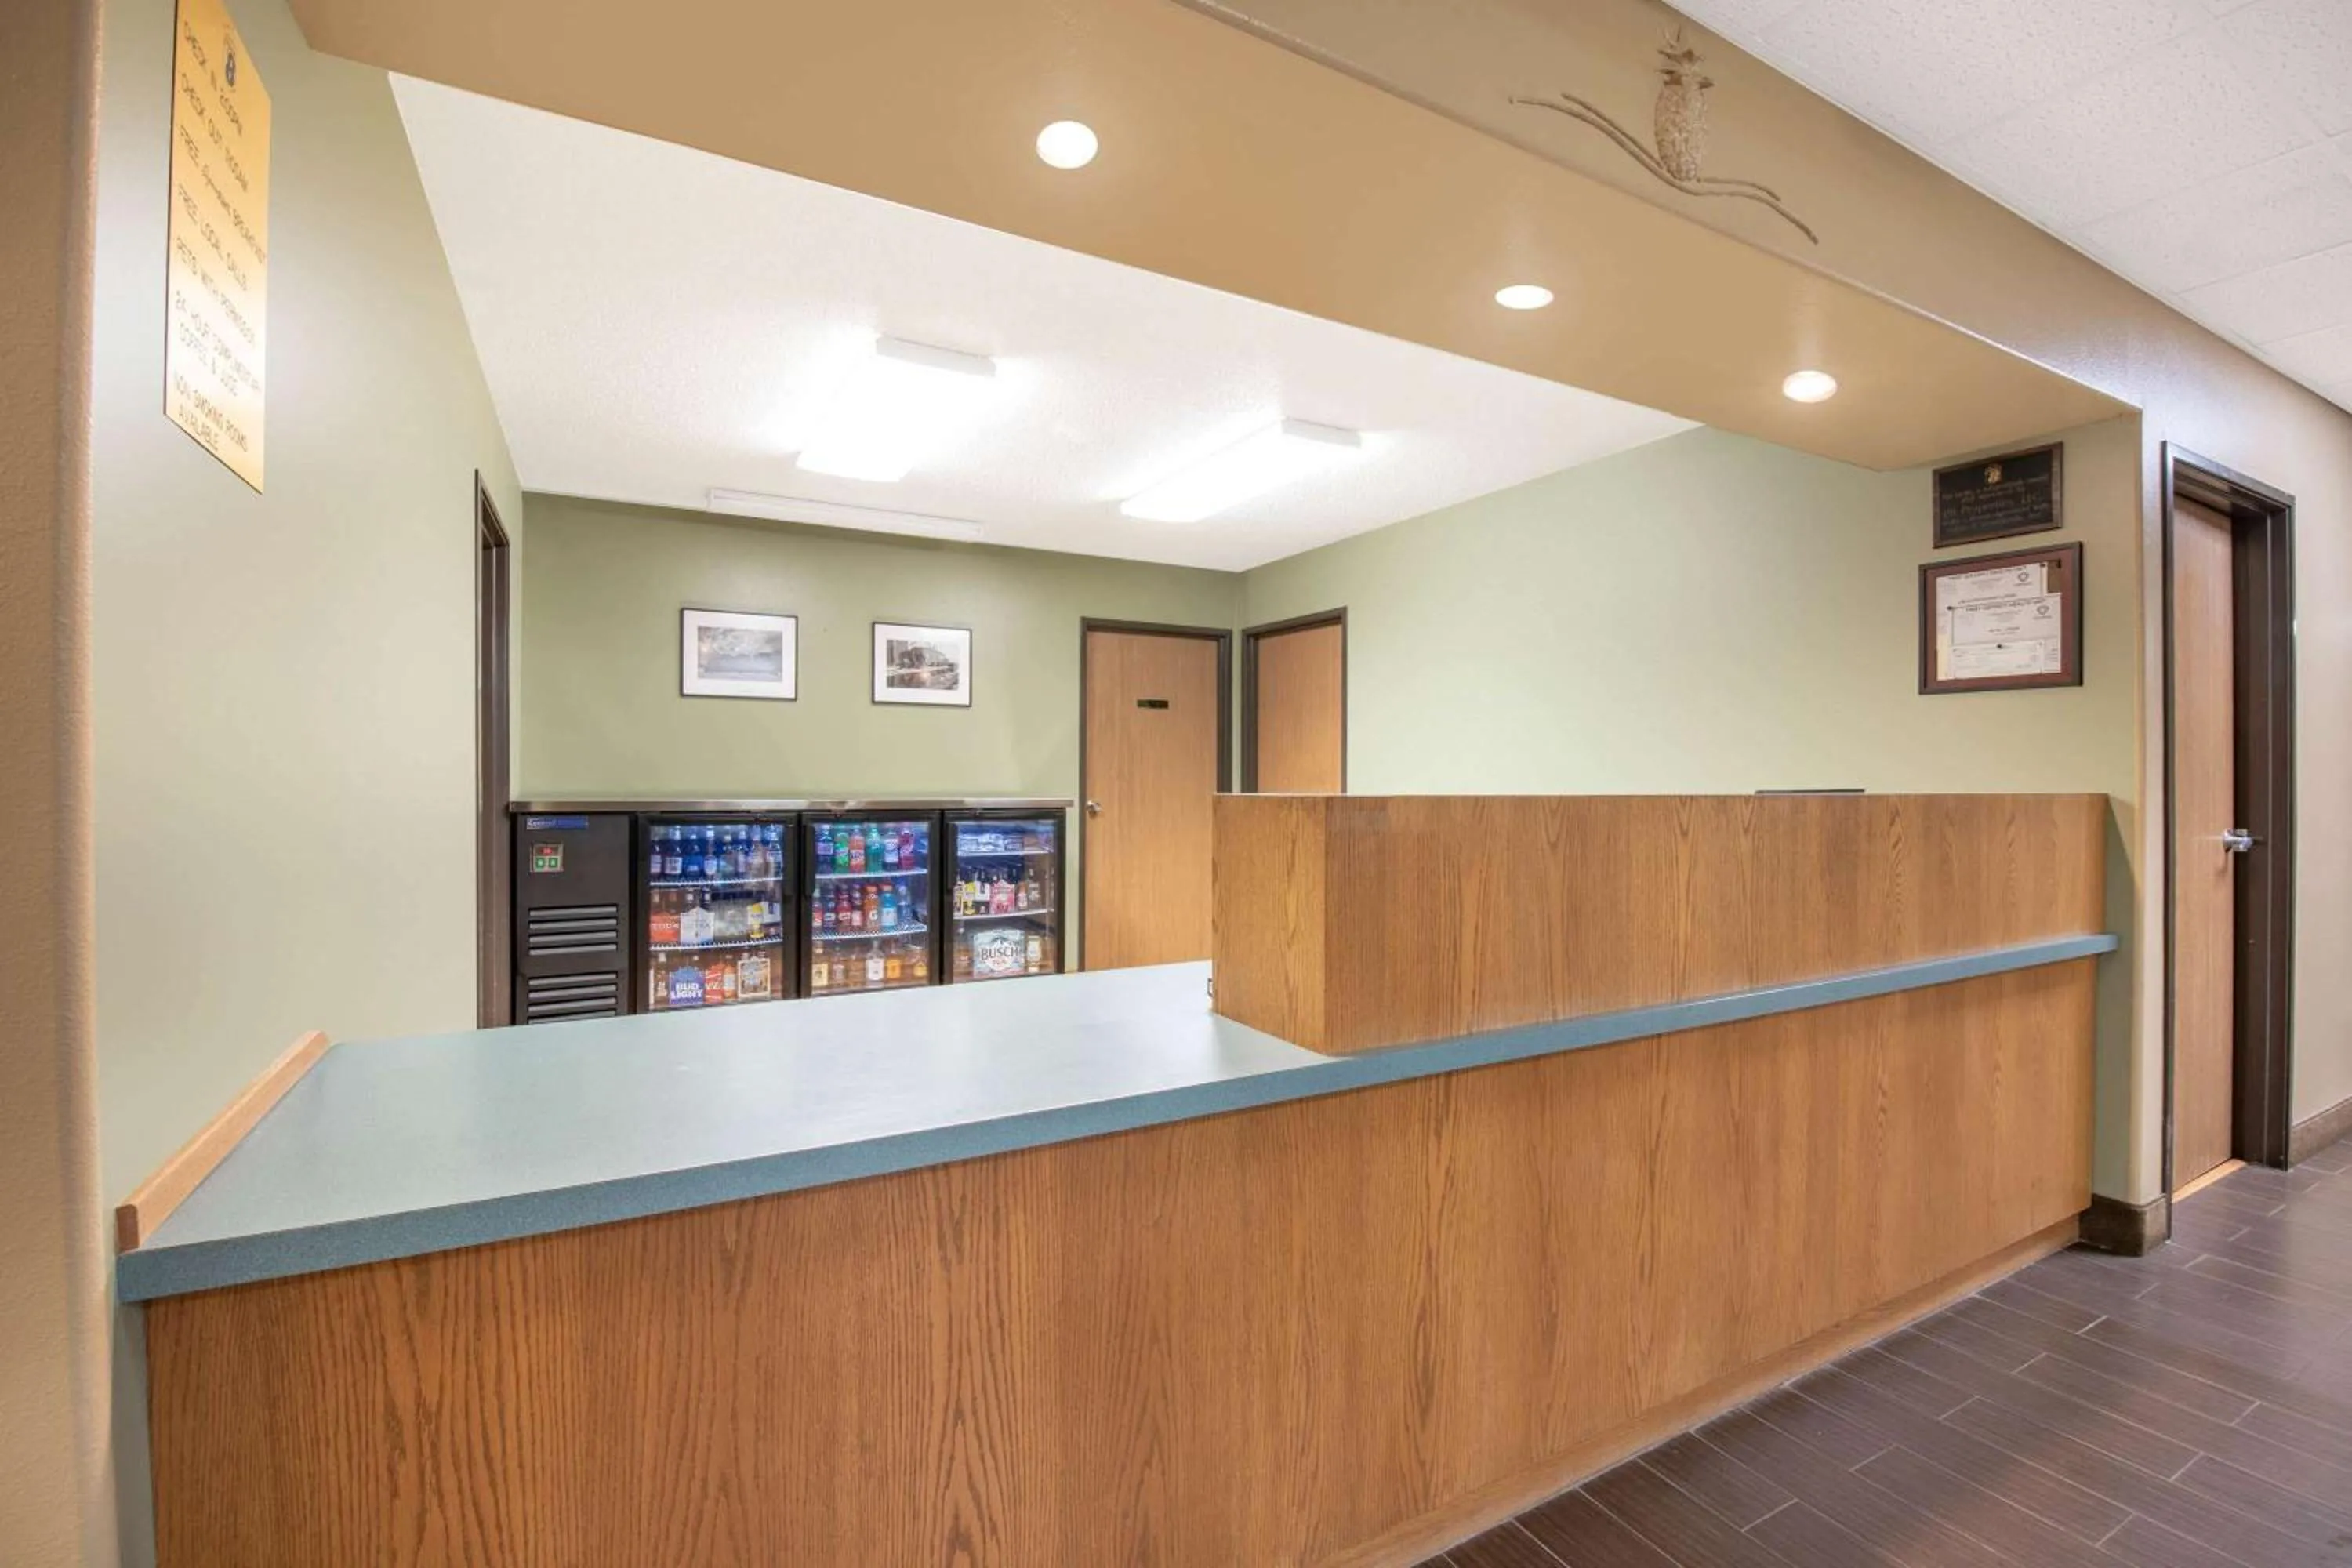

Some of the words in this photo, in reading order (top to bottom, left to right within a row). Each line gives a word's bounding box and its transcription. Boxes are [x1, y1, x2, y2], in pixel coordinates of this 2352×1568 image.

[185, 22, 206, 67] CHECK
[182, 73, 205, 116] CHECK
[209, 118, 222, 148] OUT
[181, 125, 199, 167] FREE
[180, 184, 198, 225] FREE
[981, 946, 1018, 960] BUSCH
[670, 989, 702, 999] LIGHT
[675, 982, 699, 991] BUD
